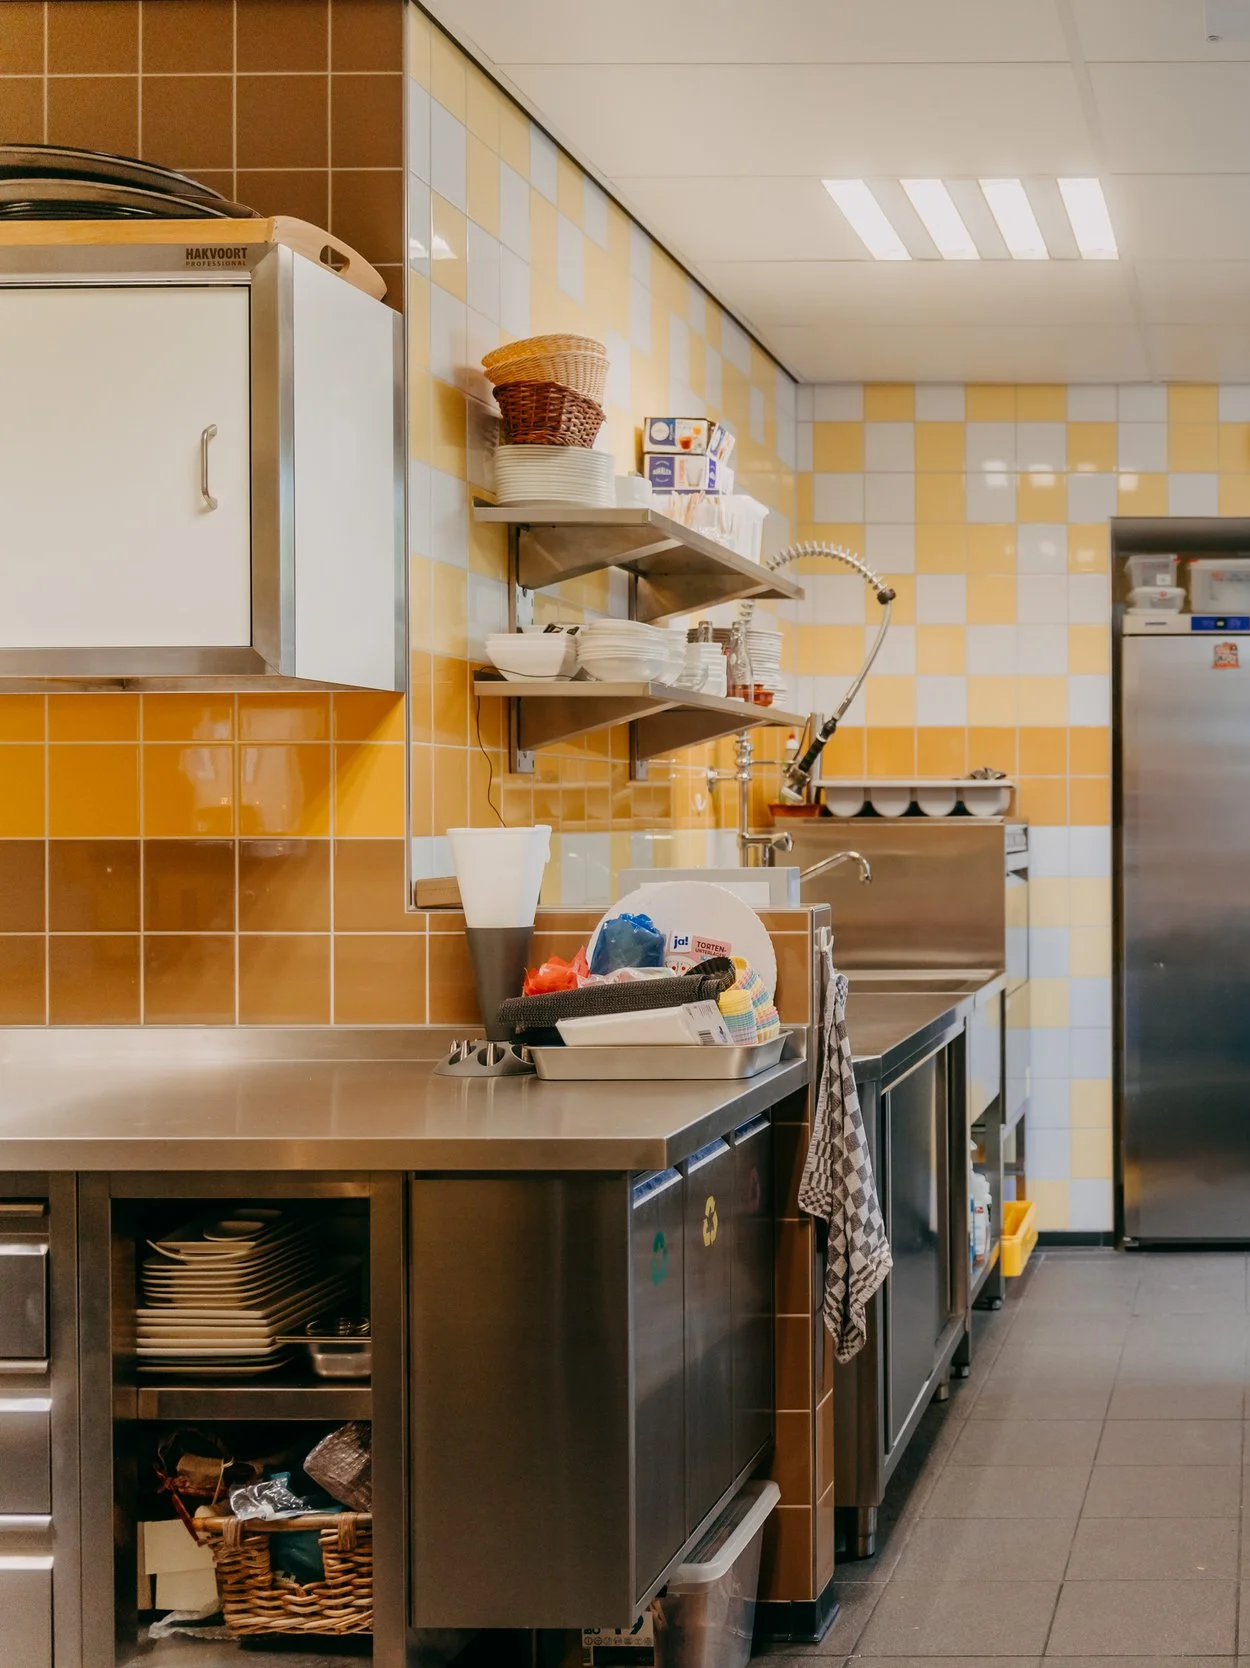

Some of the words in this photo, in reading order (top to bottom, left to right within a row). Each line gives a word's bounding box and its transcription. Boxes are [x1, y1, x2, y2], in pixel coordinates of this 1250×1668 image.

[186, 247, 248, 260] HAKVOORT
[186, 260, 247, 268] PROFESSIONAL
[673, 935, 689, 950] ja!
[697, 940, 727, 953] TORTEN-
